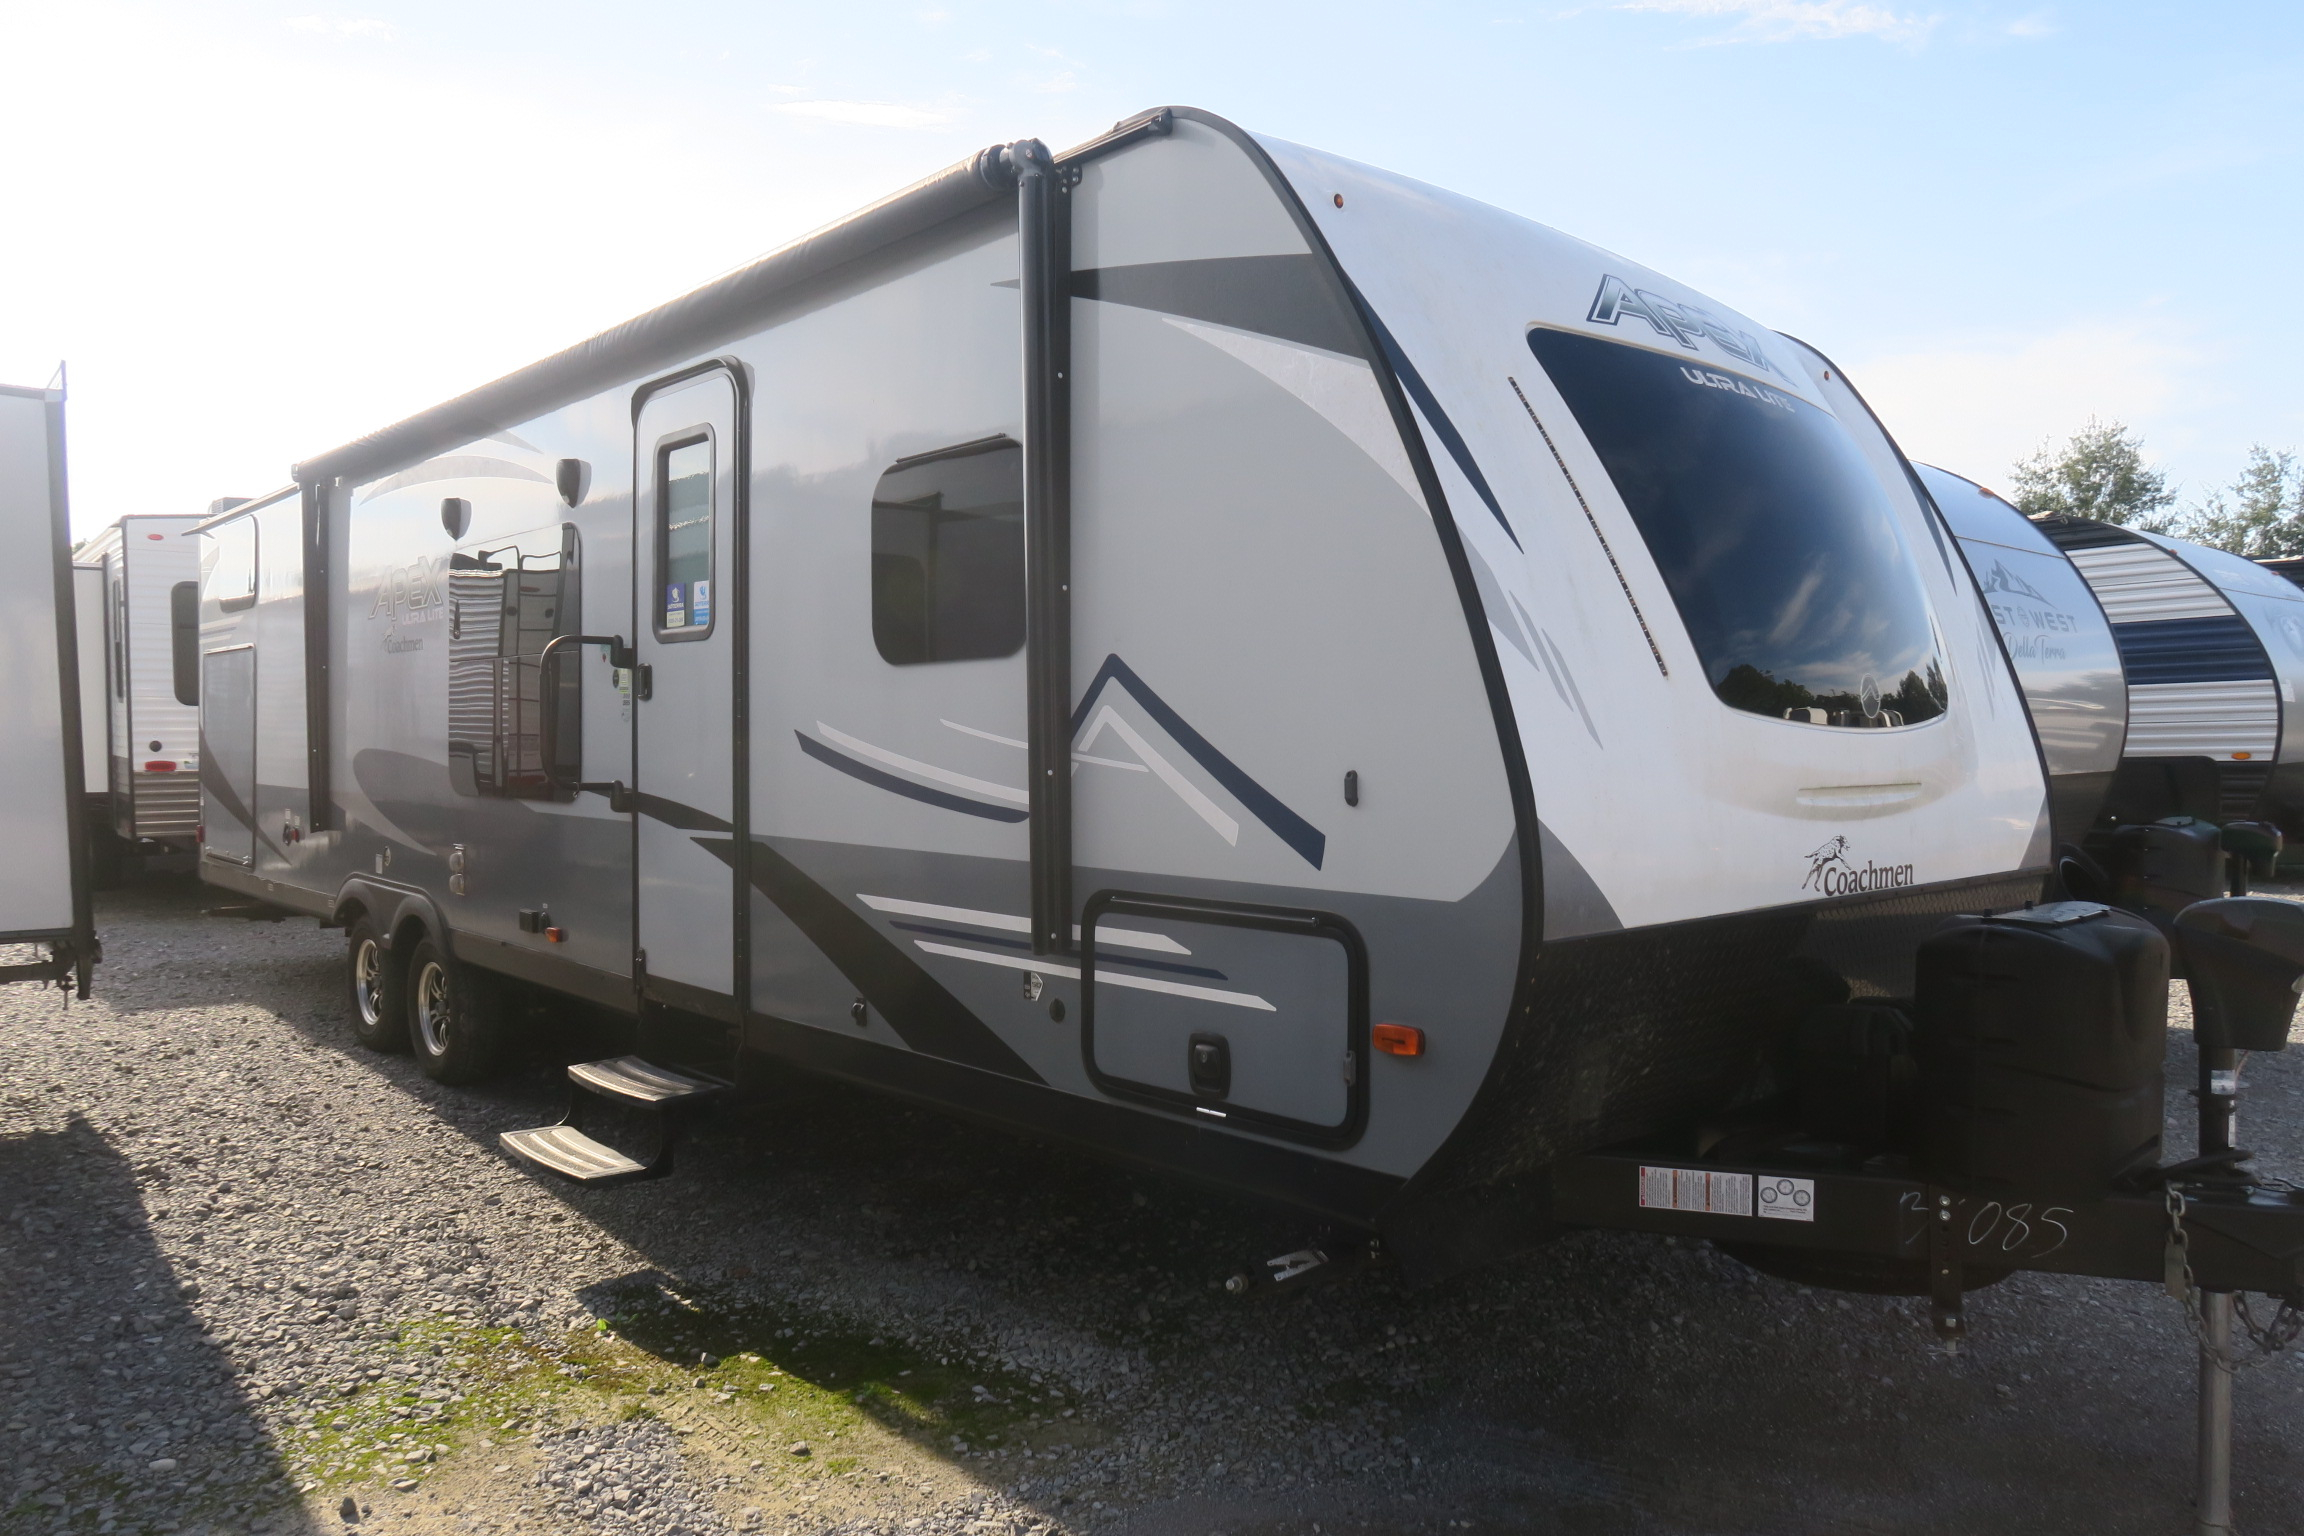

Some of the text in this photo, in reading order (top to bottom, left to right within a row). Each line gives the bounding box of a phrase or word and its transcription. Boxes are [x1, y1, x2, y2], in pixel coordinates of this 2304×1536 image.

[1679, 366, 1796, 414] ULTRA LITE
[368, 555, 443, 621] APEX
[427, 606, 444, 620] LITE
[1990, 604, 2016, 627] ST
[2028, 609, 2078, 633] WEST
[387, 636, 424, 654] Coachmen
[2034, 634, 2066, 665] Terra
[1823, 860, 1914, 897] Coachmen
